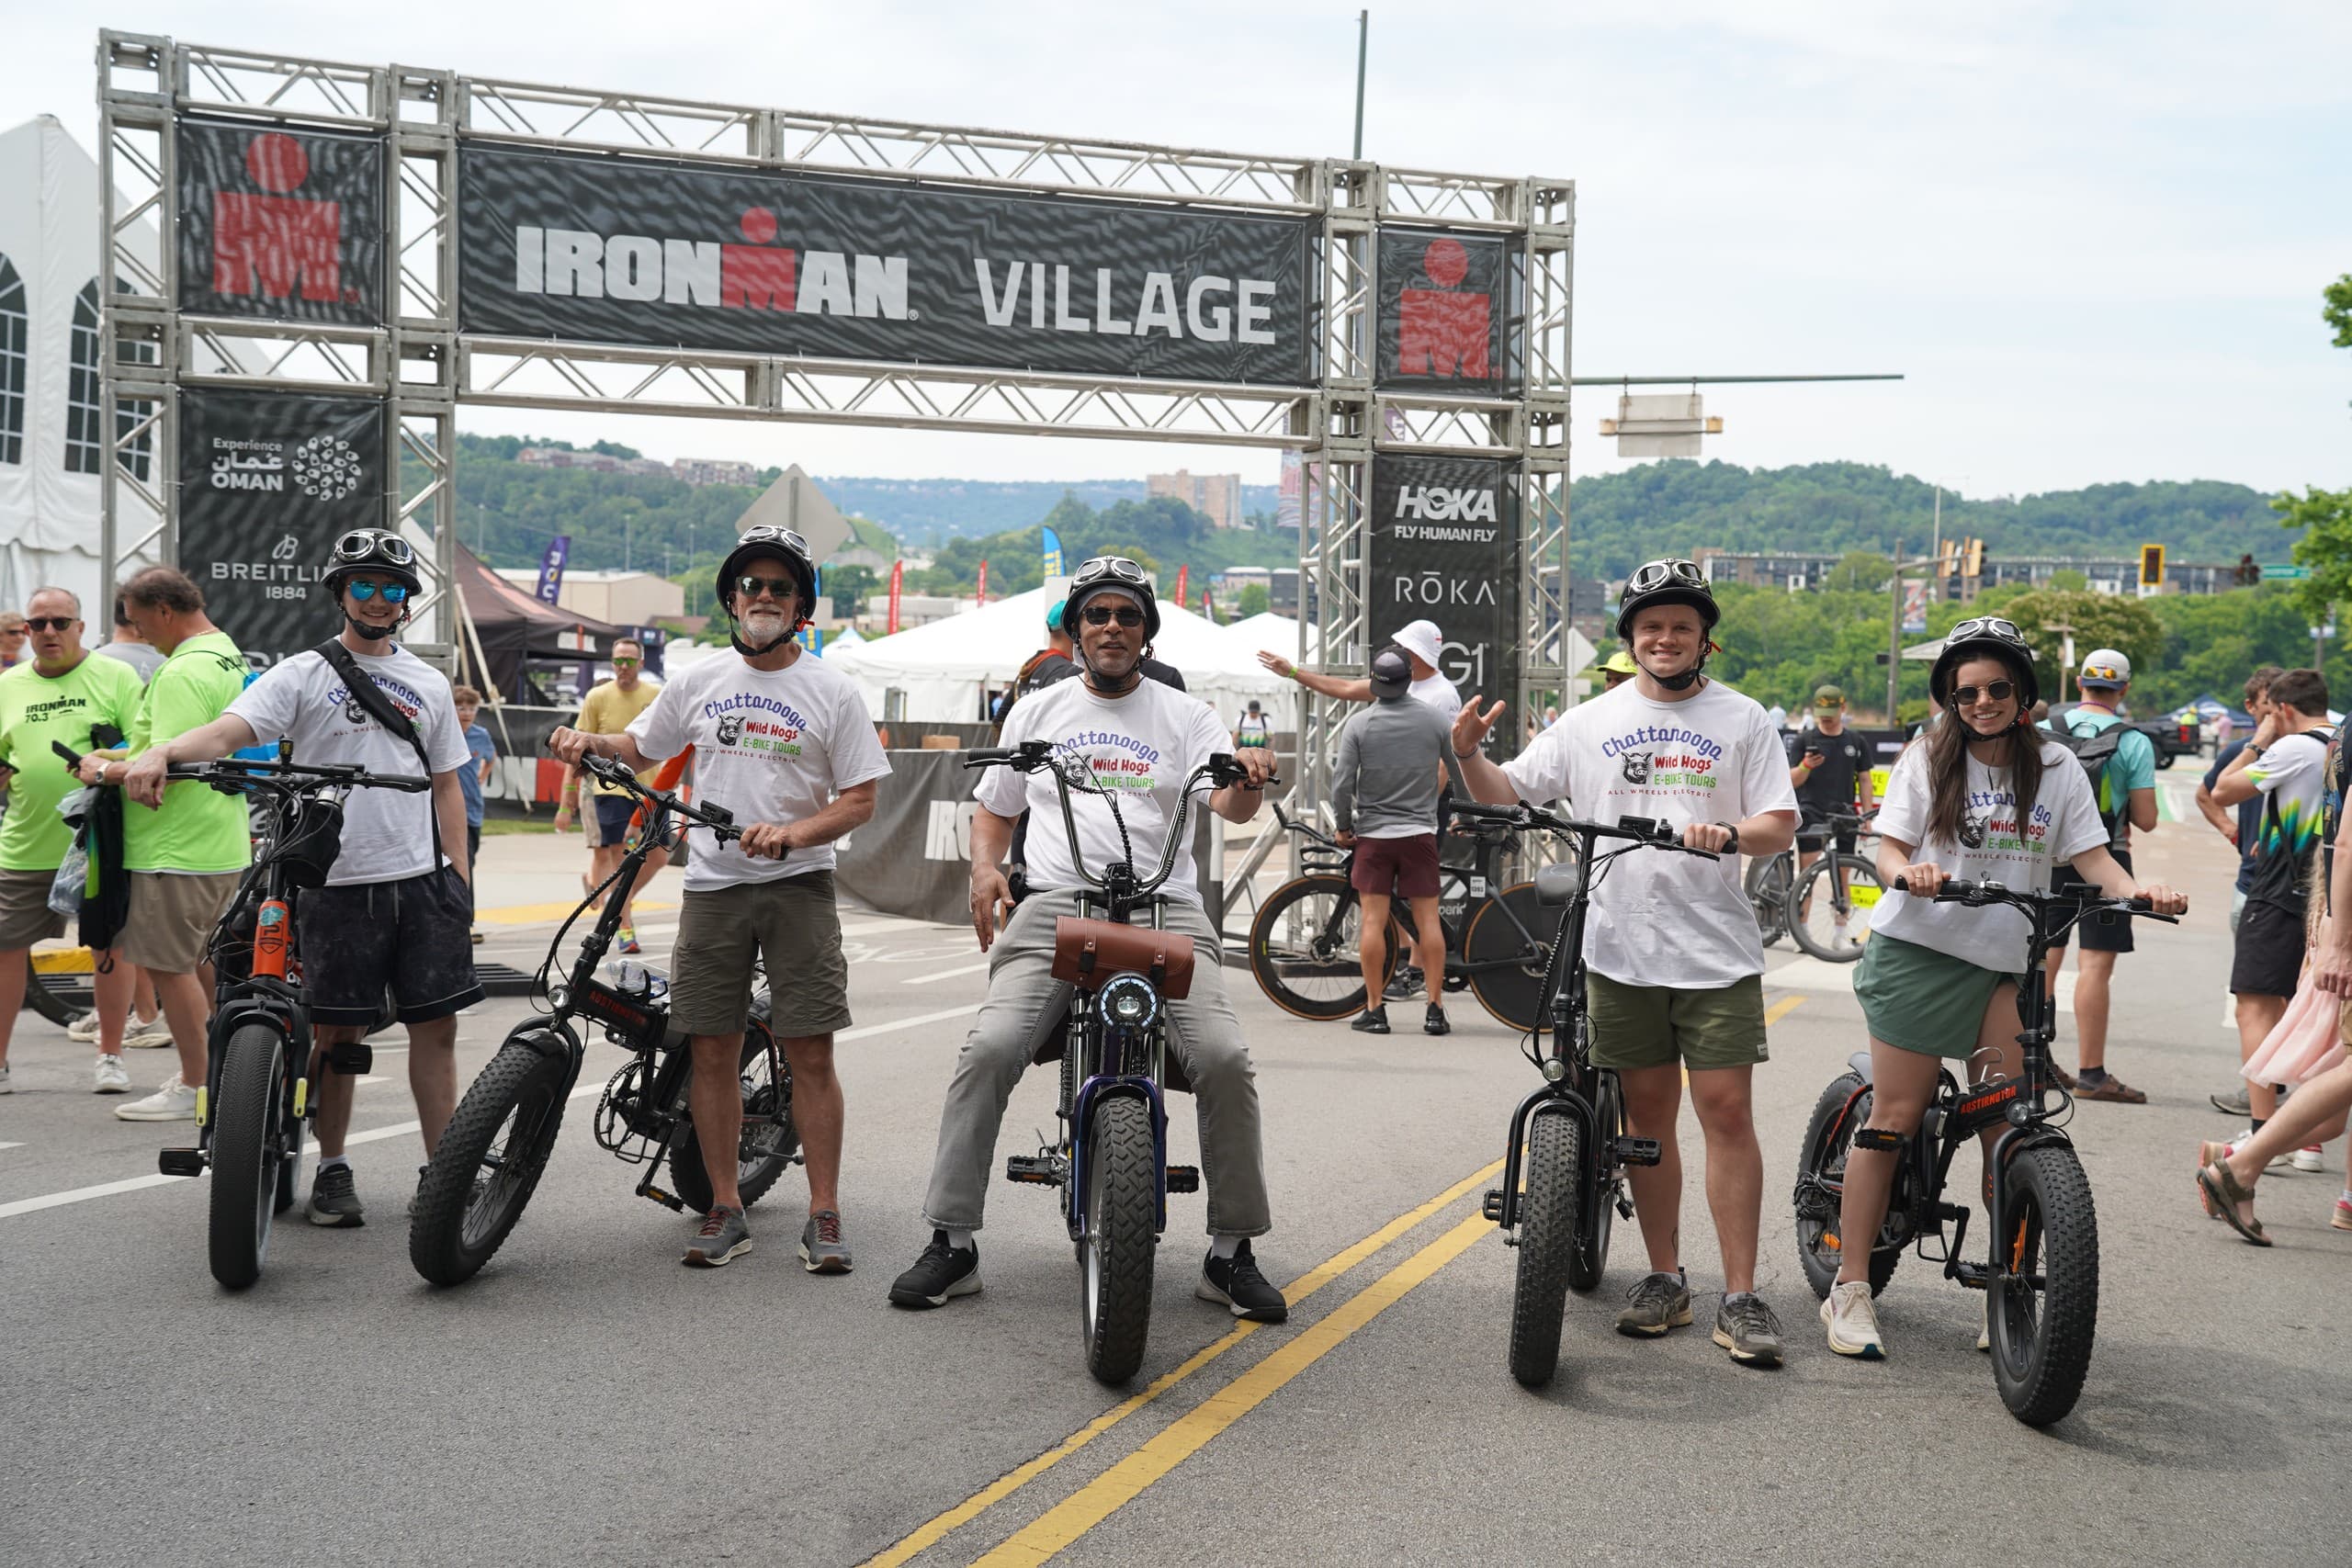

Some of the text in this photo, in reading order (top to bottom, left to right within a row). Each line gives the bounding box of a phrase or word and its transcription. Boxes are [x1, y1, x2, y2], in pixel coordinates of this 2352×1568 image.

[516, 208, 1276, 345] IRONMAN VILLAGE
[212, 437, 283, 451] Experience
[211, 472, 284, 491] OMAN
[1395, 485, 1497, 522] HOKA
[1395, 525, 1497, 542] FLY HUMAN FLY
[211, 562, 327, 582] BREITLI
[266, 587, 306, 600] 1884
[26, 695, 86, 714] IRONMAN
[705, 693, 807, 731] Chattanooga
[25, 713, 49, 723] 70.3
[746, 721, 798, 742] Wild Hogs
[742, 738, 802, 756] E-BIKE TOURS
[1601, 726, 1722, 761] Chattanooga
[719, 750, 753, 758] WHEELS
[1093, 759, 1150, 776] Wild Hogs
[1655, 755, 1712, 773] Wild Hogs
[1091, 776, 1155, 788] E-BIKE TOURS
[1654, 773, 1716, 788] E-BIKE TOURS
[1673, 790, 1712, 798] ELECTRIC
[1990, 819, 2017, 834] Wild
[1987, 838, 2021, 850] E-BIKE
